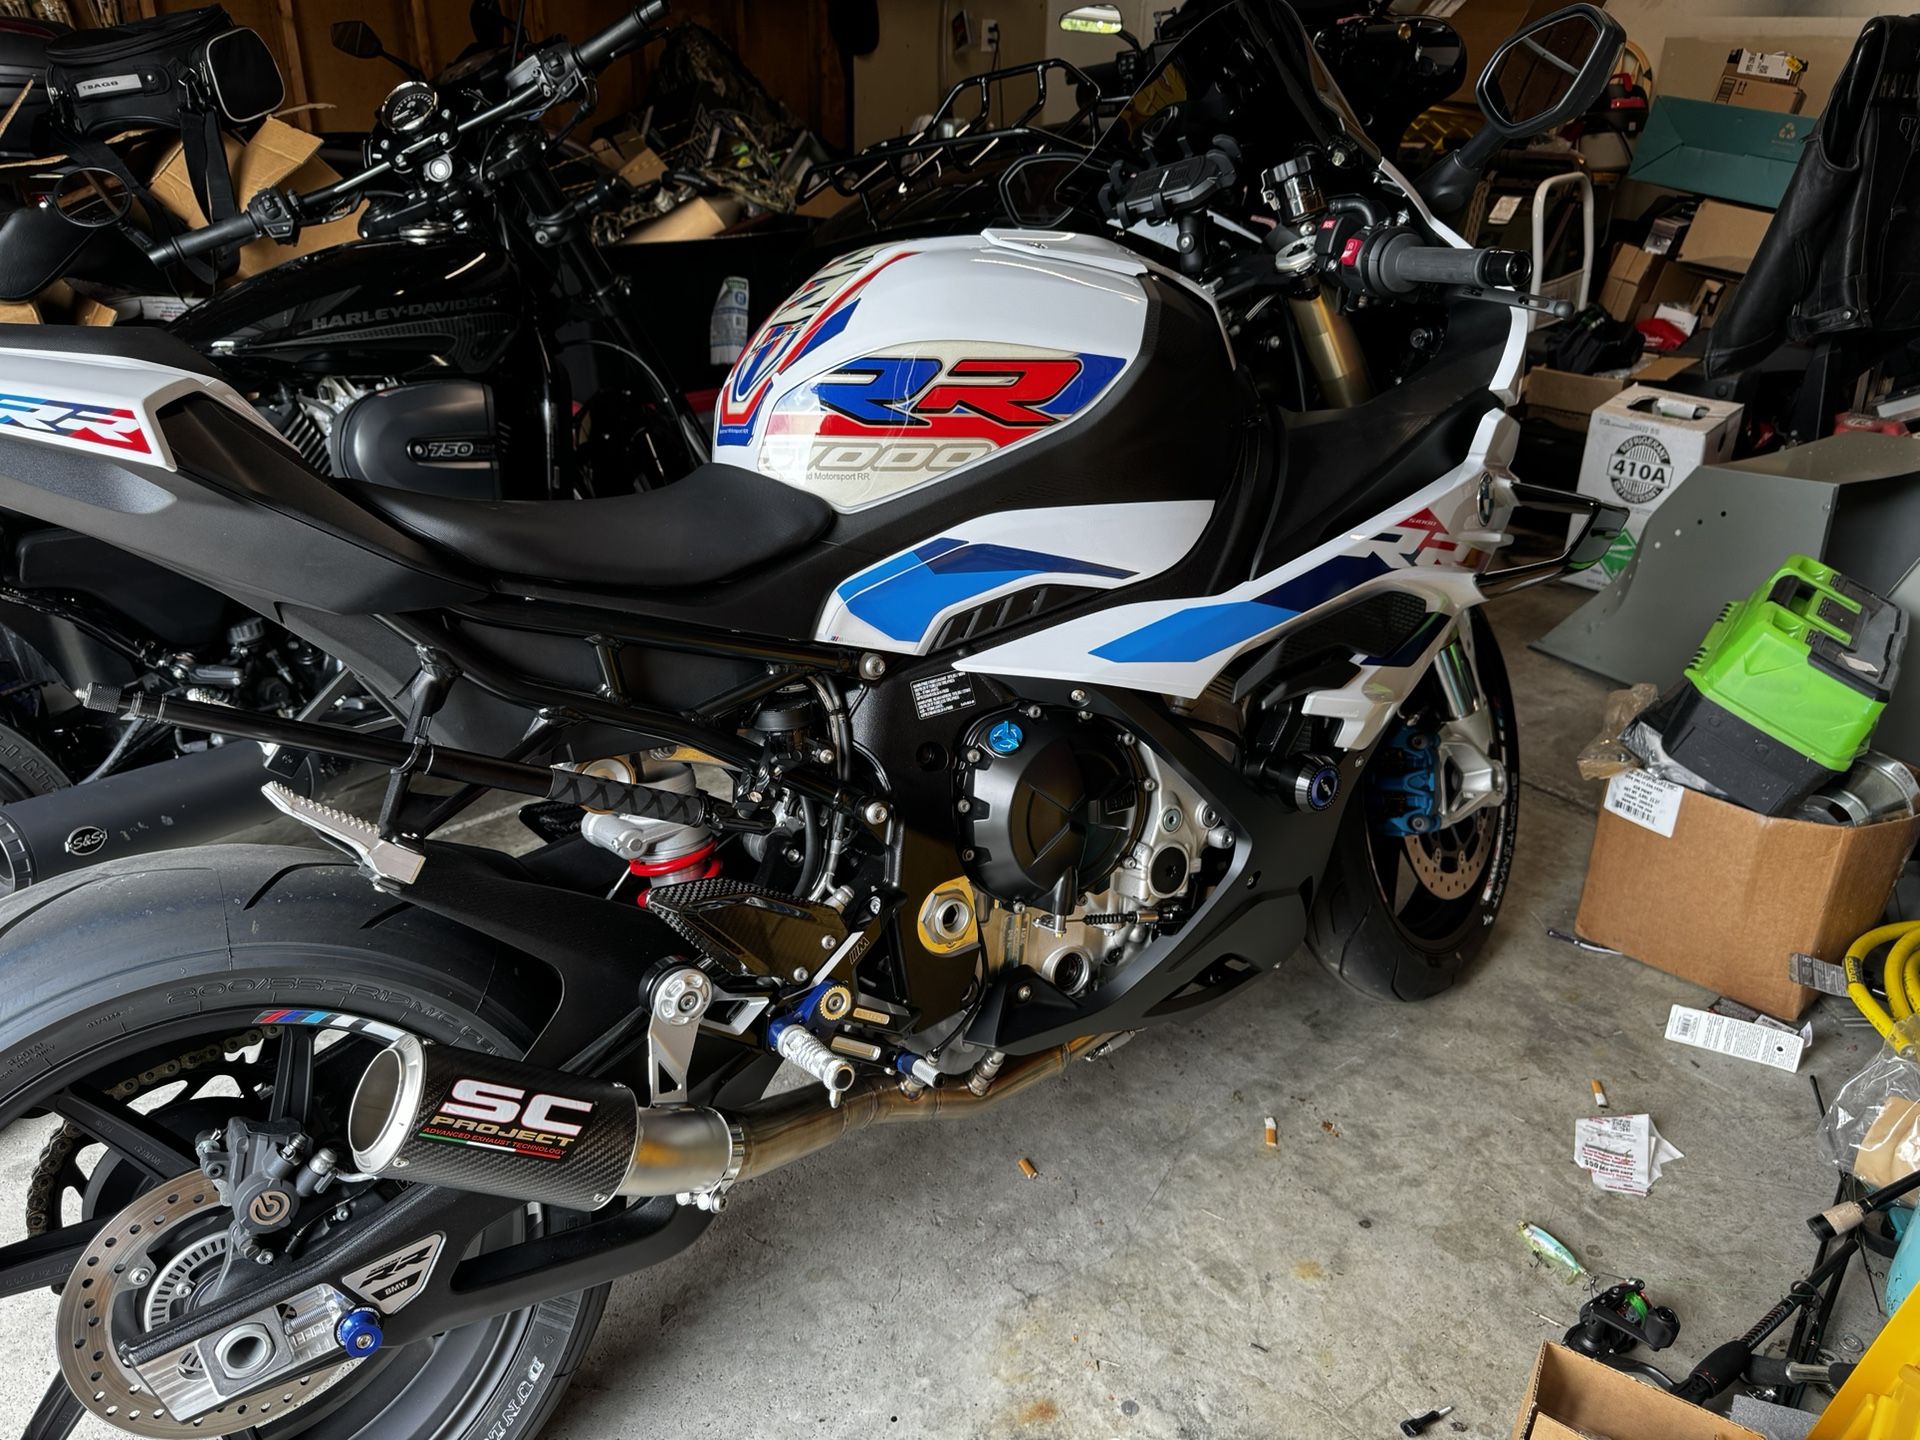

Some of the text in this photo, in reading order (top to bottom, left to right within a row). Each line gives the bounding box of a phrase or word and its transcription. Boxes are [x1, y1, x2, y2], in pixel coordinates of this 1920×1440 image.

[818, 357, 1084, 428] RR
[428, 442, 474, 457] 750
[814, 472, 857, 482] Motorsport
[856, 472, 870, 481] RR
[1613, 459, 1666, 484] 410A
[73, 831, 102, 850] S&S
[439, 1079, 593, 1136] SC
[422, 1126, 568, 1156] ADVANCED EXHAUST TECHNOLOGY
[429, 1115, 575, 1147] PROJECT
[358, 1245, 432, 1290] RR
[384, 1279, 409, 1296] BMW
[483, 1355, 545, 1440] DUNL
